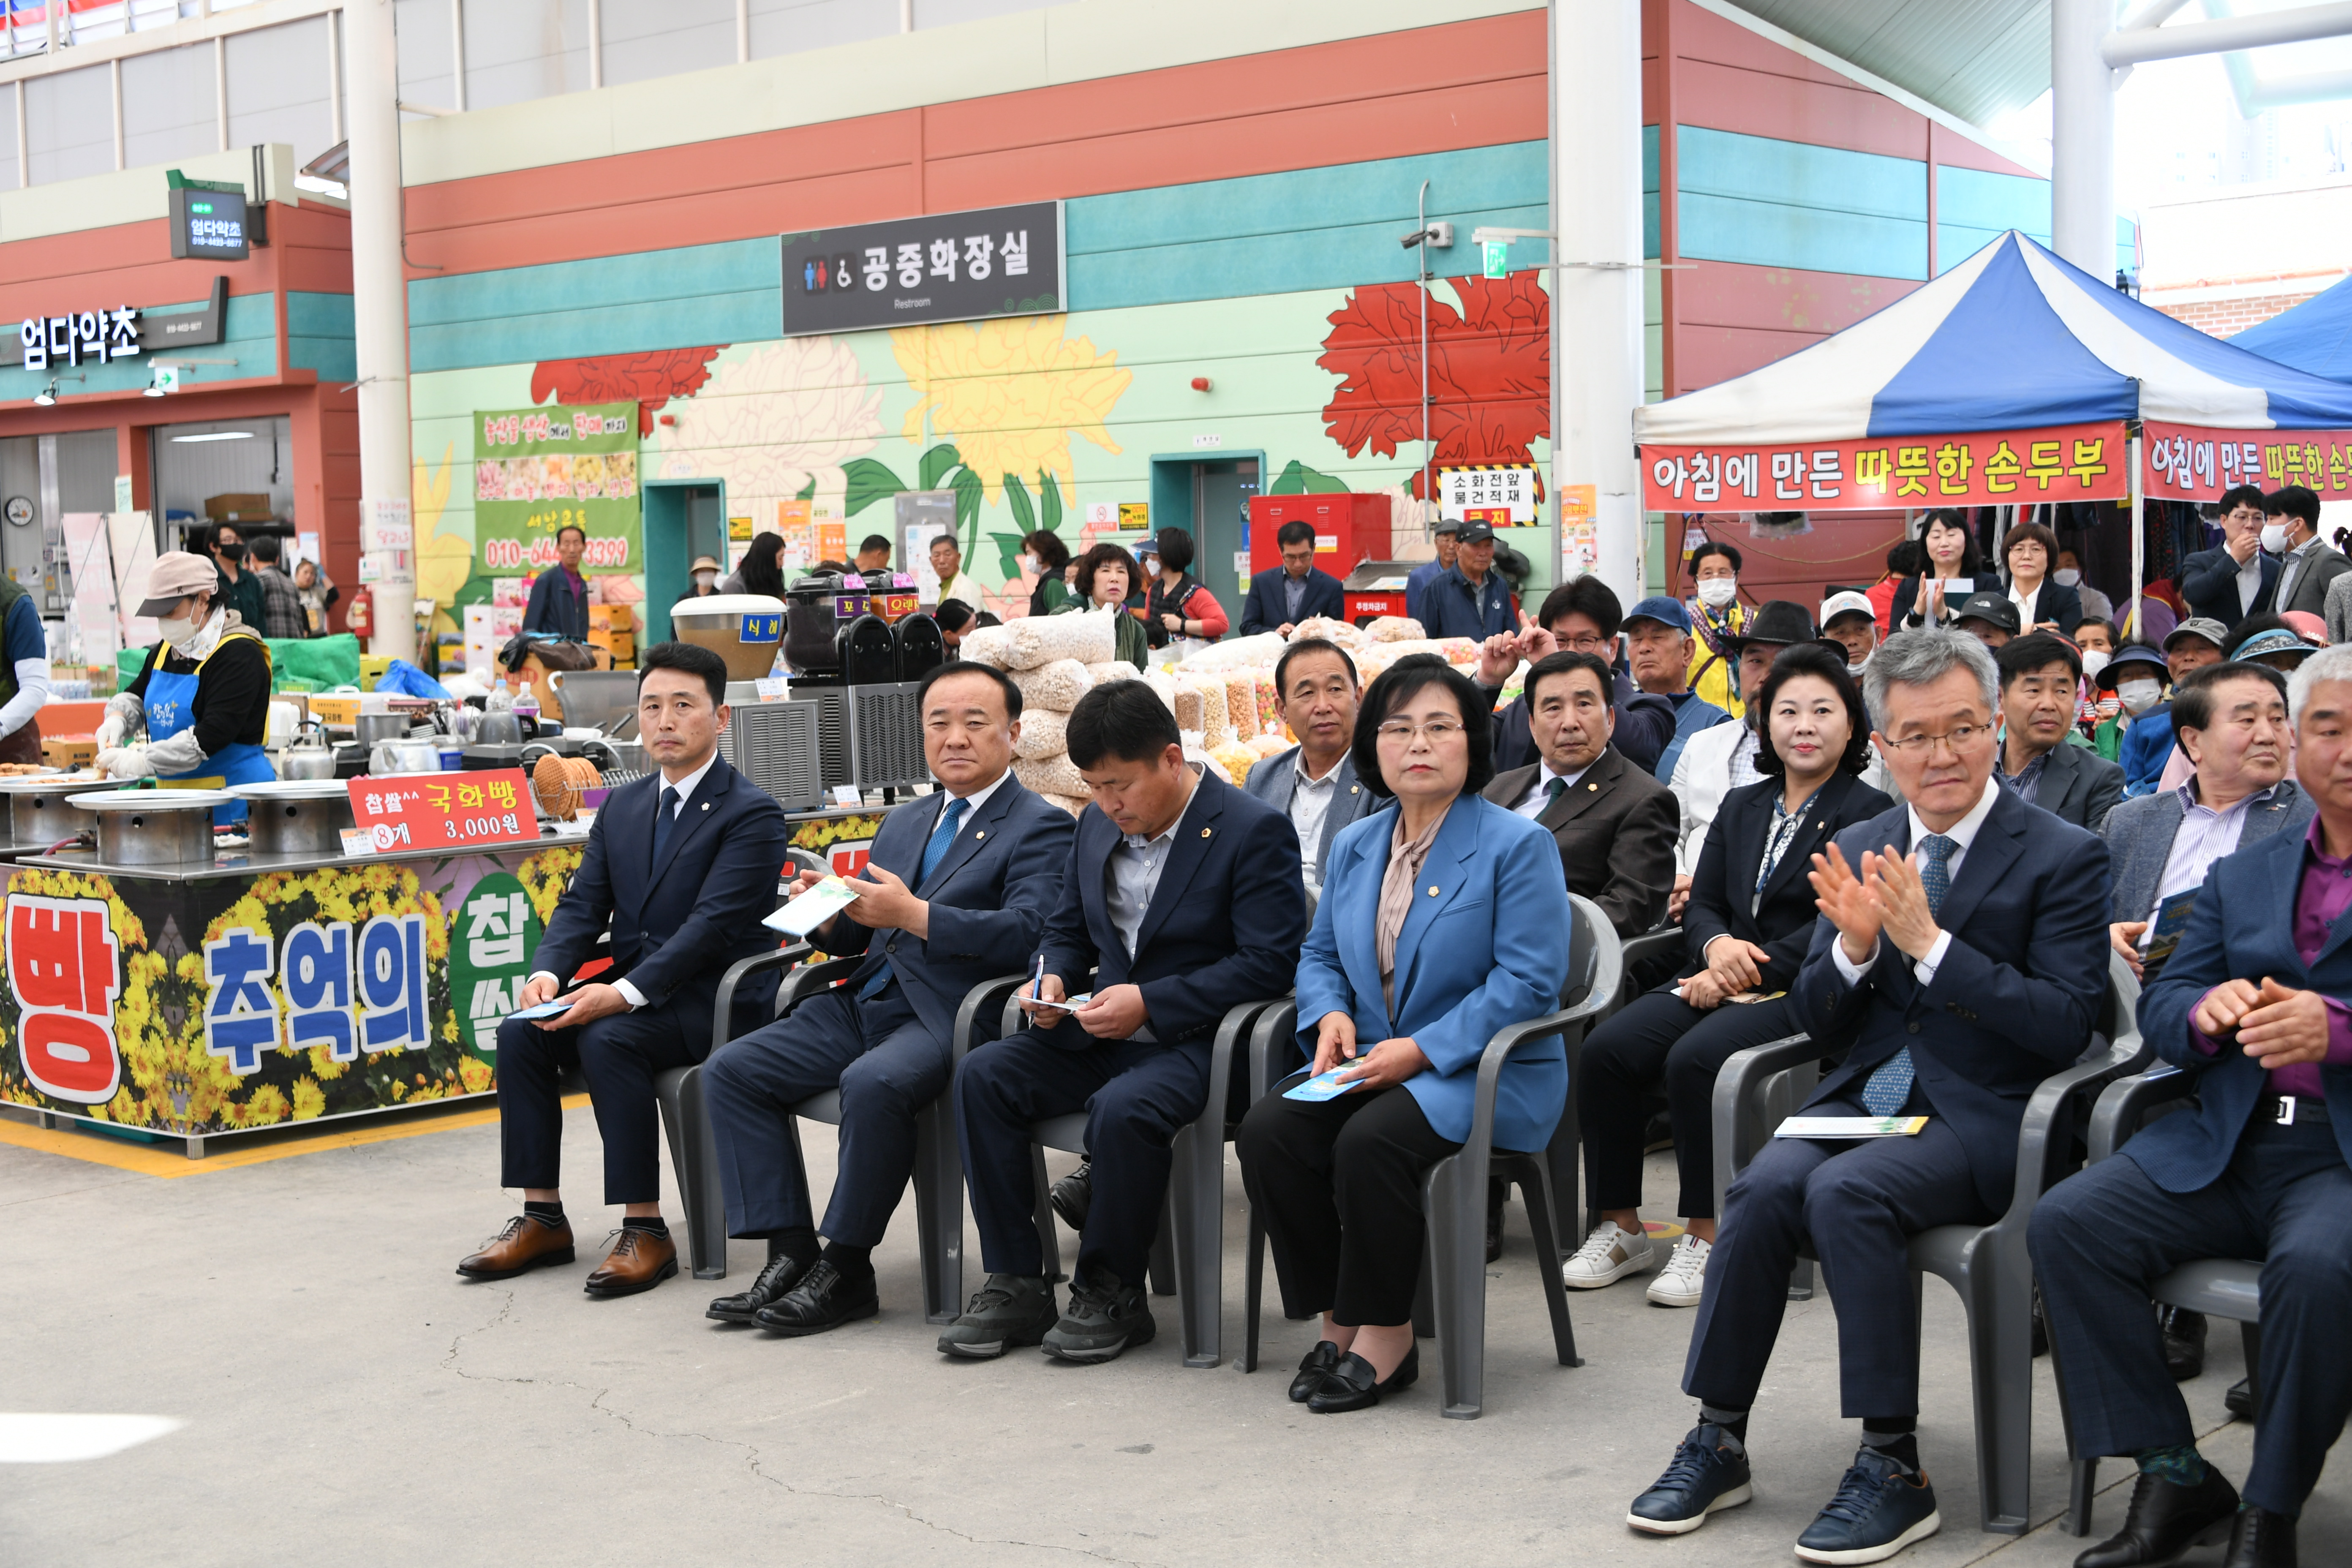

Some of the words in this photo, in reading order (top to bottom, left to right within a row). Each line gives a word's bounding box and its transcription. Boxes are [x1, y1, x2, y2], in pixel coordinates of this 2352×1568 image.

[191, 219, 242, 237] 엄다약초
[863, 230, 1029, 291] 공중화장실
[894, 298, 931, 309] Restroom
[21, 305, 139, 370] 엄다약초
[485, 415, 519, 445] 농산물
[1653, 451, 1759, 502] 아침에
[1771, 450, 1843, 499] 만든
[1855, 442, 1974, 497] 따뜻한
[1984, 438, 2107, 493] 손두부
[2151, 435, 2215, 490] 아침에
[2220, 441, 2262, 491] 만든
[2265, 441, 2325, 491] 따뜻한
[2329, 442, 2352, 491] 손
[1454, 490, 1519, 504] 물건적재
[1356, 602, 1388, 612] 주정차금지
[425, 781, 517, 814] 국화빵
[445, 813, 520, 841] 3,000원
[8, 896, 118, 1100] 빵
[205, 914, 430, 1075] 추억의
